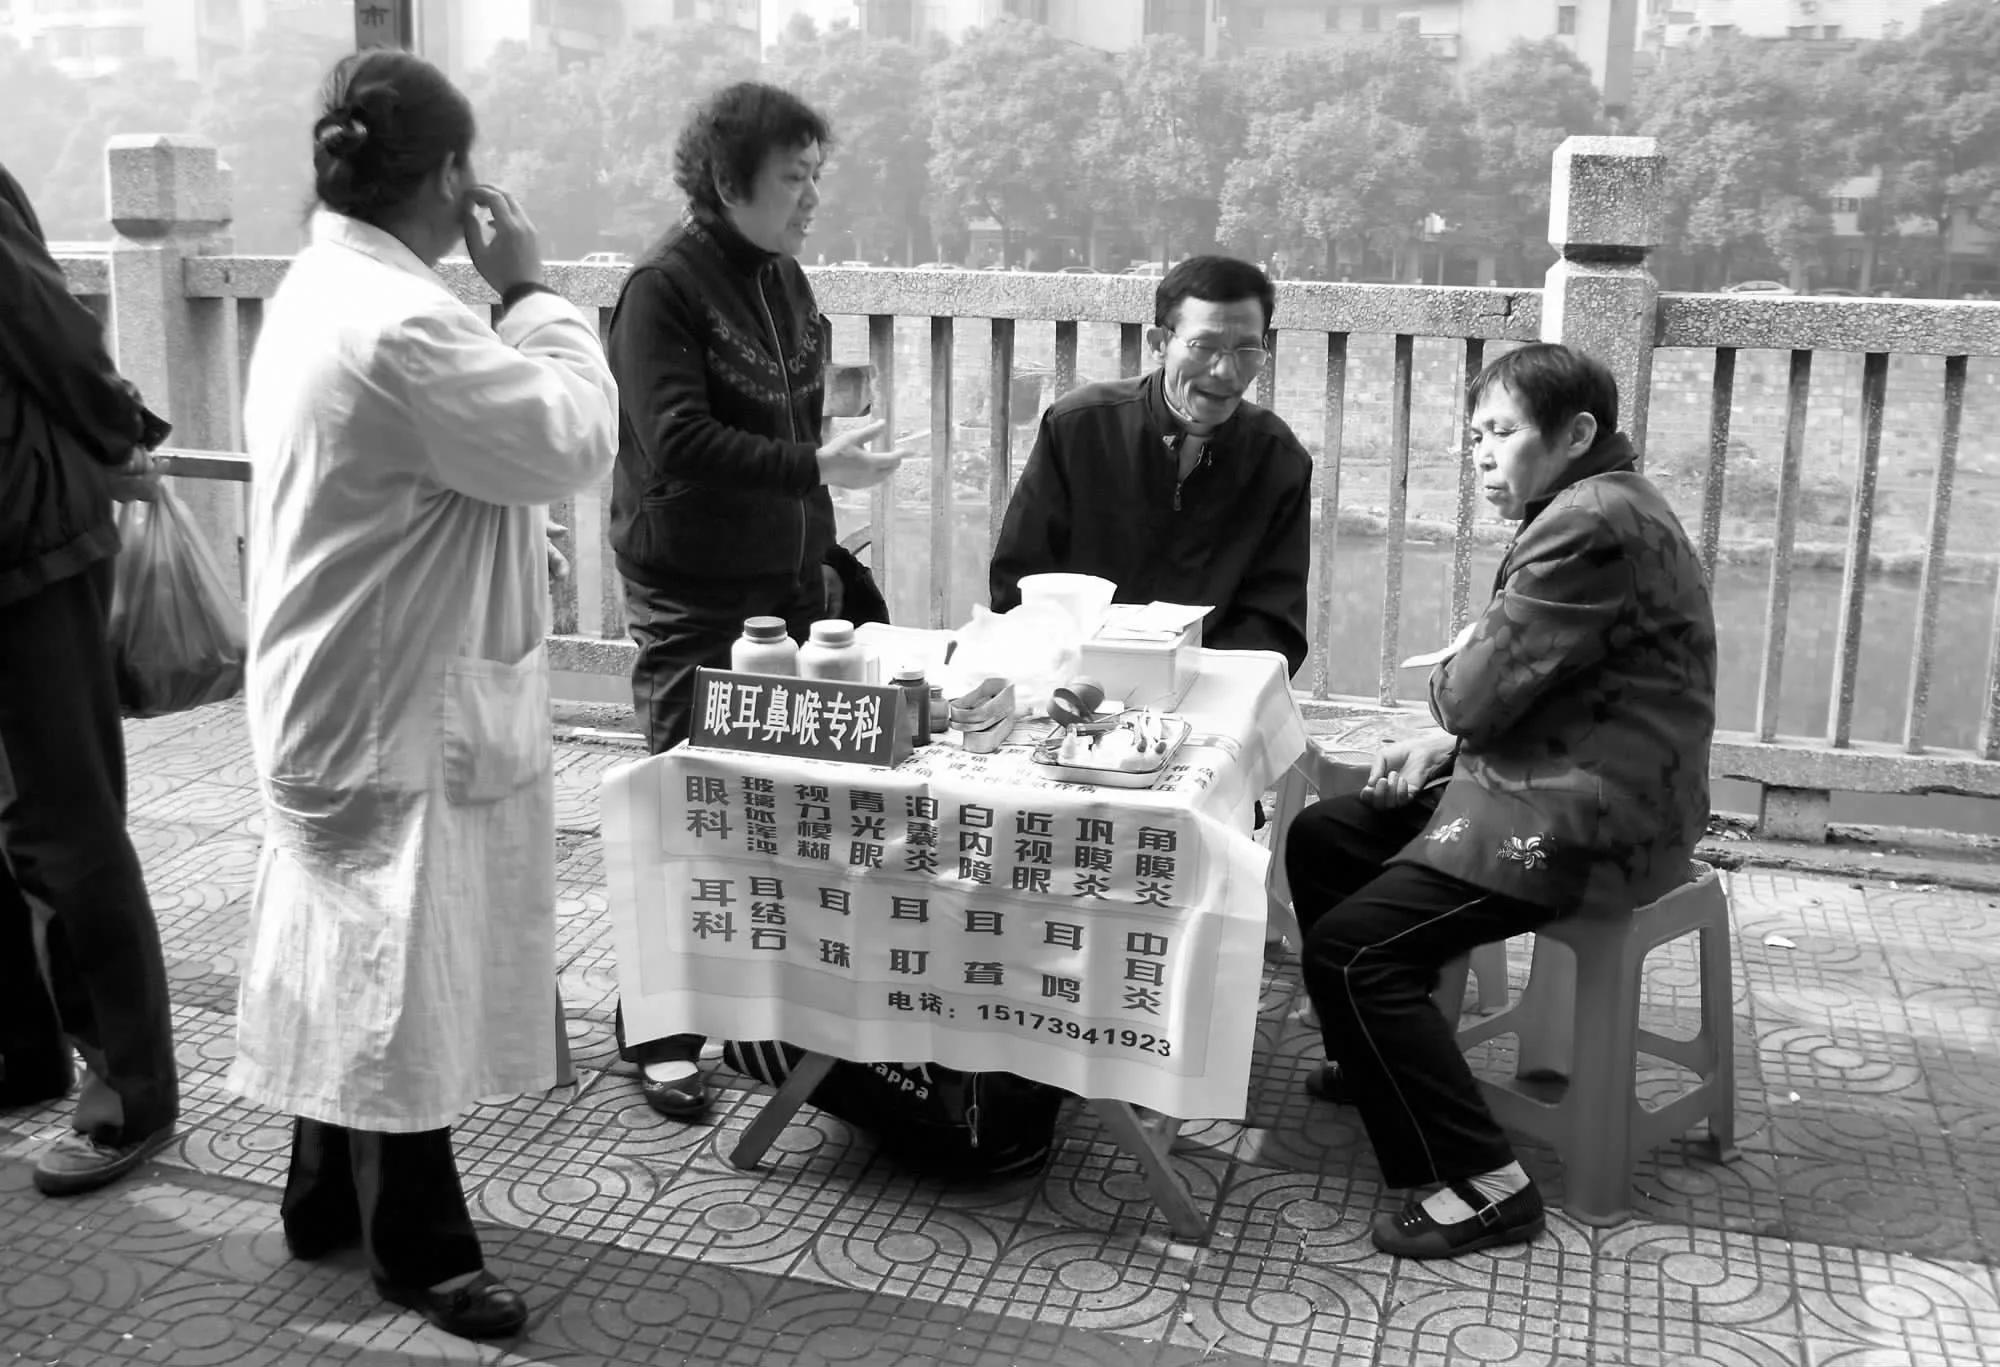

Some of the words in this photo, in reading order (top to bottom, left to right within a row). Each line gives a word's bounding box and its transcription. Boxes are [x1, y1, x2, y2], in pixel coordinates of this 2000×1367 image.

[704, 681, 882, 753] 眼耳鼻喉专科
[686, 775, 734, 840] 眼科
[793, 783, 833, 862] 视力模糊
[848, 788, 886, 871] 青光眼
[903, 794, 941, 875] 泪囊炎
[958, 803, 994, 885] 白内障
[1012, 811, 1054, 894] 近视眼
[1072, 817, 1115, 901] 巩膜炎
[1132, 825, 1177, 909] 角膜炎
[691, 878, 737, 942] 耳科
[748, 875, 788, 951] 耳结石
[1041, 920, 1084, 1003] 耳鸣
[1121, 931, 1169, 1015] 中耳炎
[977, 1003, 1171, 1057] 15173941923
[867, 1063, 929, 1100] appa
